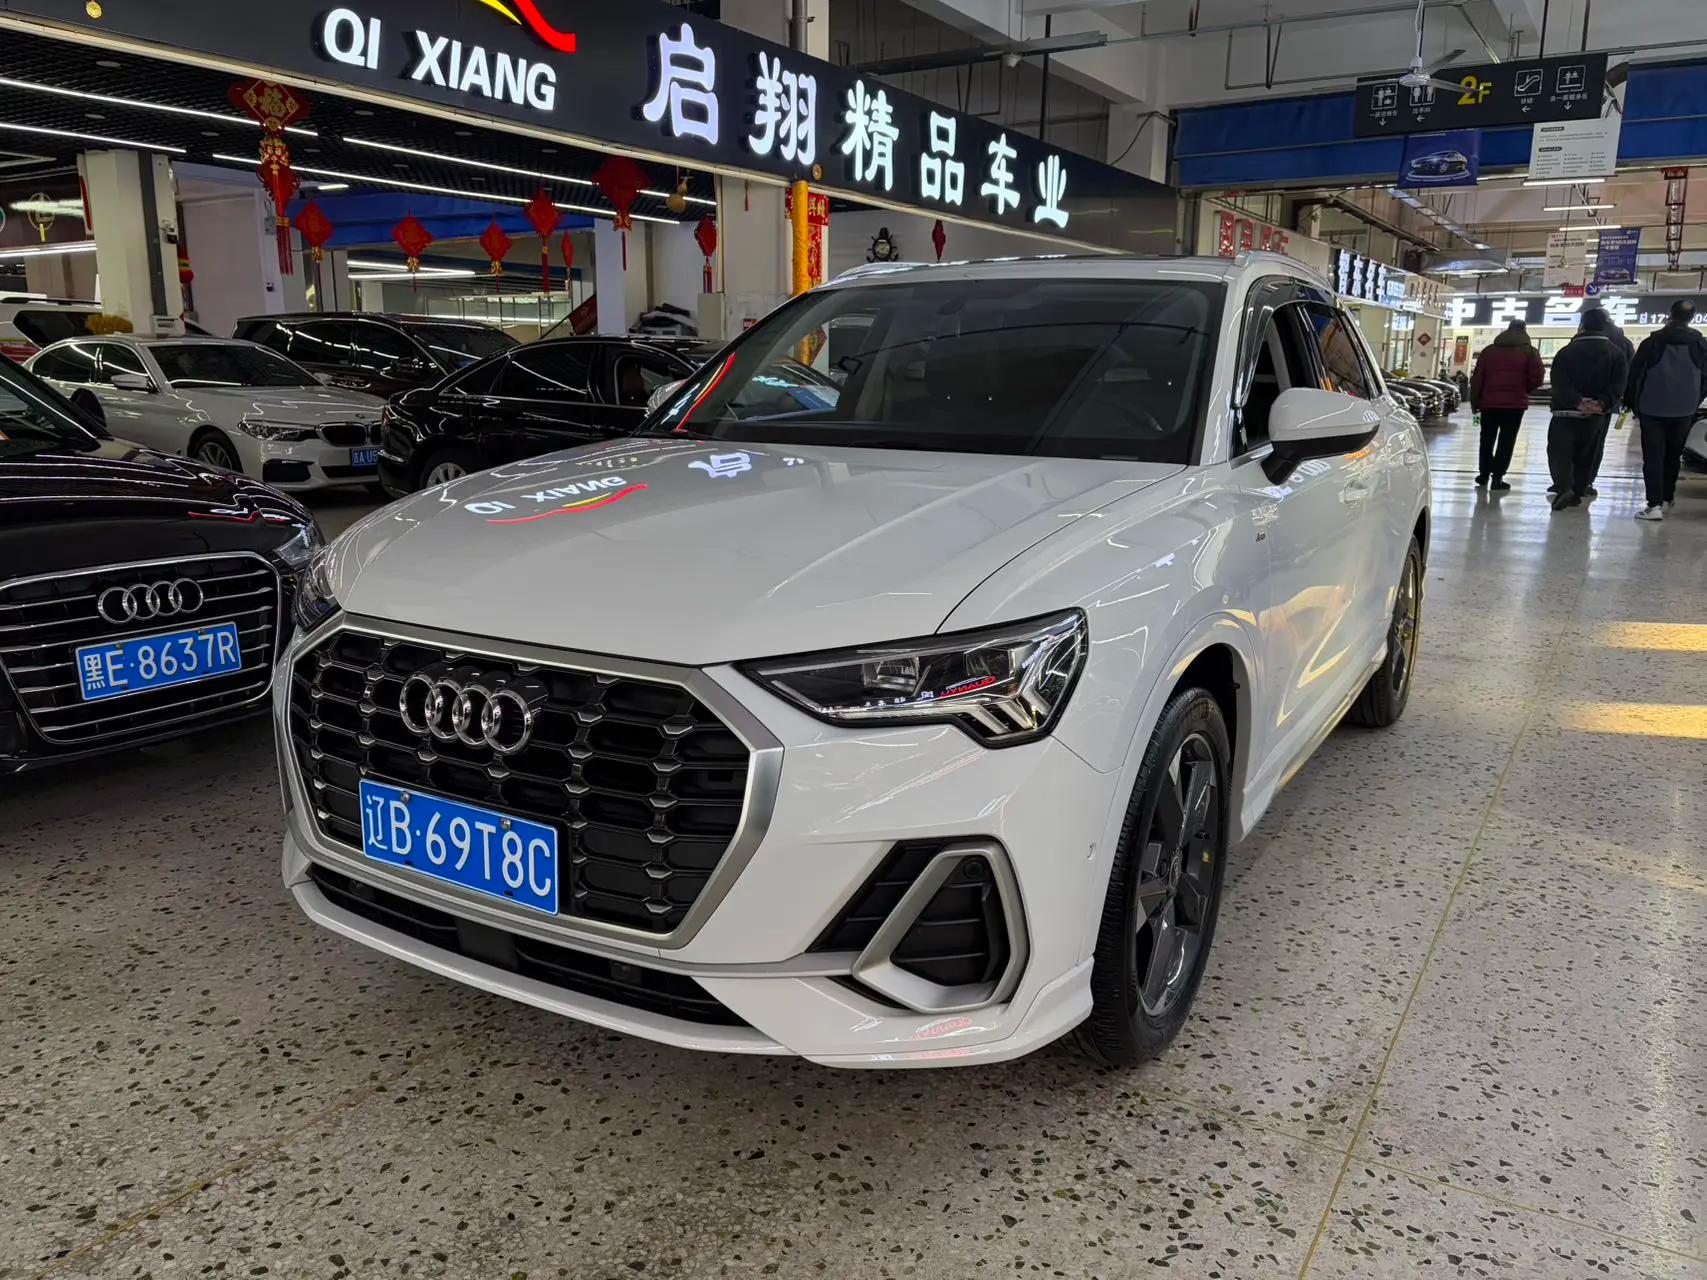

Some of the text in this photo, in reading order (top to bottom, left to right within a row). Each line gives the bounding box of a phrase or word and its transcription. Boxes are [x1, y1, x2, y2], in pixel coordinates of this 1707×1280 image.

[324, 9, 557, 111] QI XIANG
[1457, 76, 1492, 105] 2F
[643, 23, 1069, 229] 启翔精品车业
[366, 794, 551, 897] 辽B·69T8C
